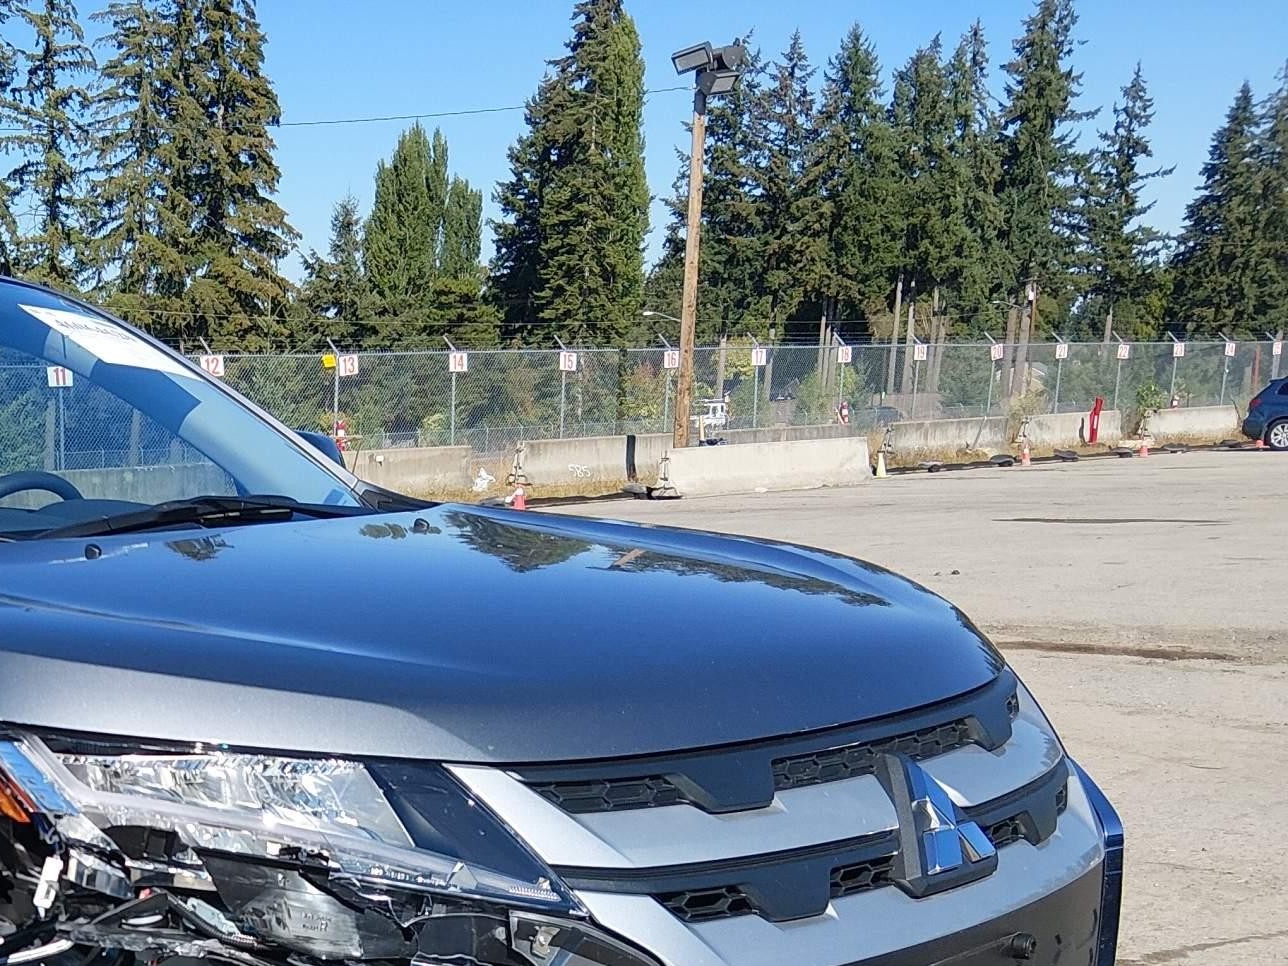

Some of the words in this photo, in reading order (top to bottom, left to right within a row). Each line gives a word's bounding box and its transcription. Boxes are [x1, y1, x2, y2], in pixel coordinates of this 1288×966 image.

[343, 356, 355, 374] 13
[453, 354, 464, 370] 14
[563, 353, 573, 370] 15
[666, 352, 677, 367] 16
[755, 350, 763, 364] 17
[204, 357, 220, 374] 12
[53, 367, 66, 386] 11
[568, 463, 591, 478] 585
